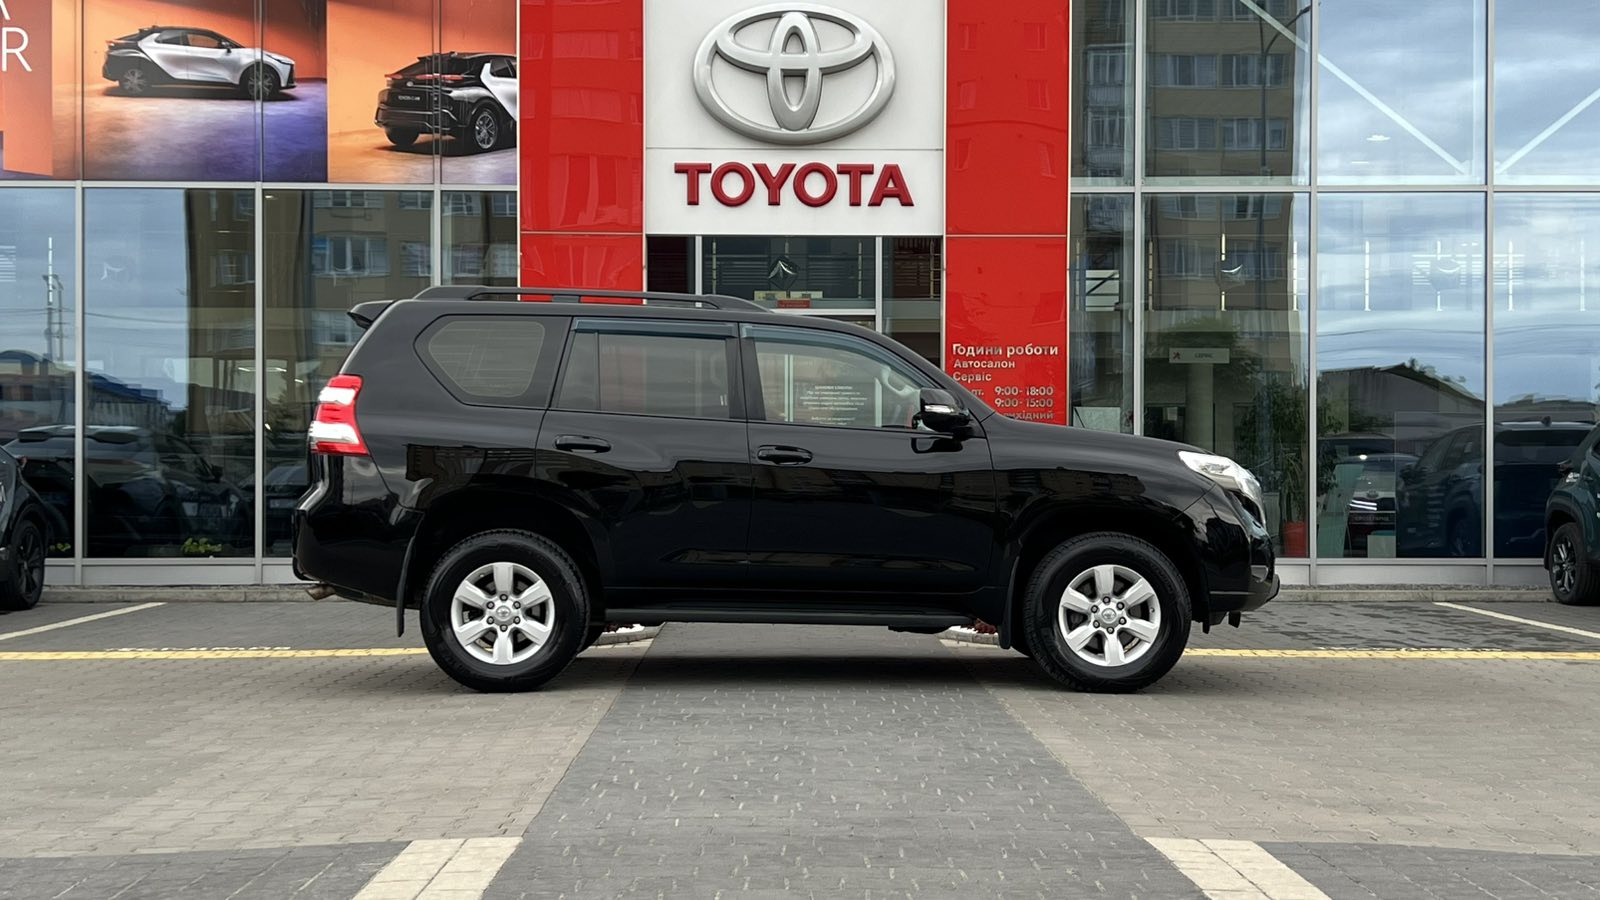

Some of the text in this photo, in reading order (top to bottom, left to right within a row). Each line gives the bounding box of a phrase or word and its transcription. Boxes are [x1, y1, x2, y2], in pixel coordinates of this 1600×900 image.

[674, 162, 915, 208] TOYOTA
[952, 343, 1058, 358] Години роботи
[953, 359, 1016, 369] Автосалон
[952, 371, 992, 383] Сервіс
